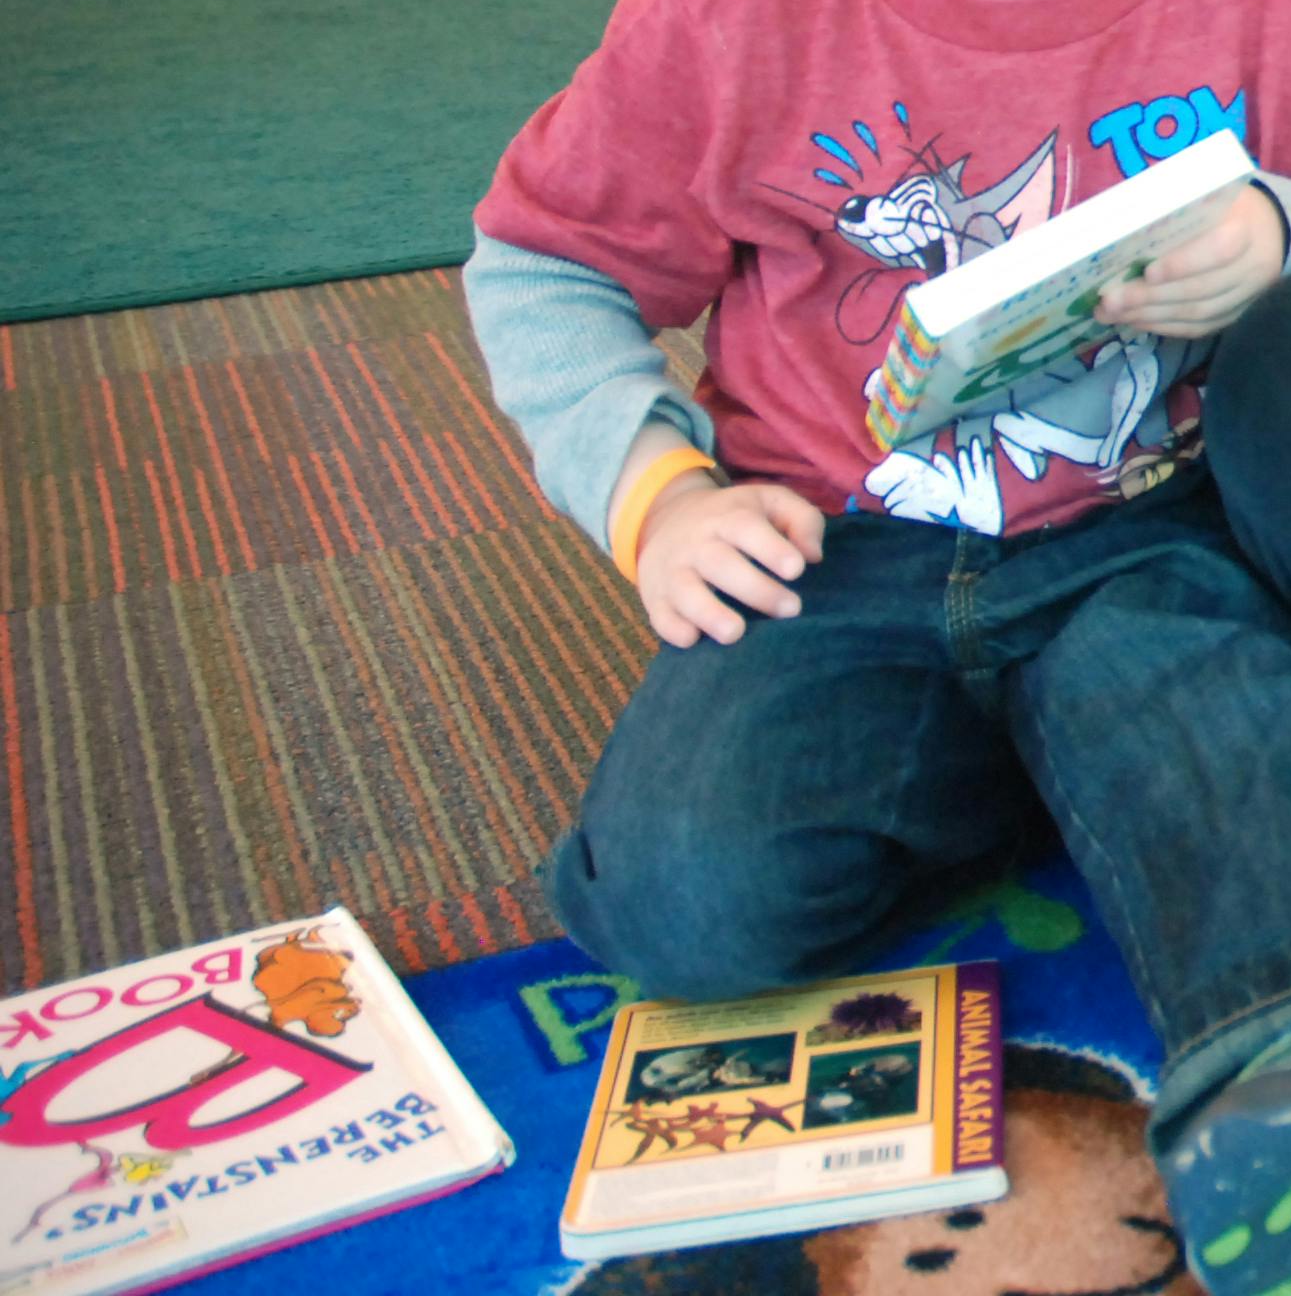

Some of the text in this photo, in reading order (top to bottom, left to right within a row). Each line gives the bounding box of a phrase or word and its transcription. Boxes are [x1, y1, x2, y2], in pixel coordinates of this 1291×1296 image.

[0, 946, 244, 1048] BOOK
[519, 972, 642, 1067] P
[0, 993, 374, 1150] B
[957, 989, 994, 1165] ANIMAL SAFARI
[348, 1119, 446, 1166] THE
